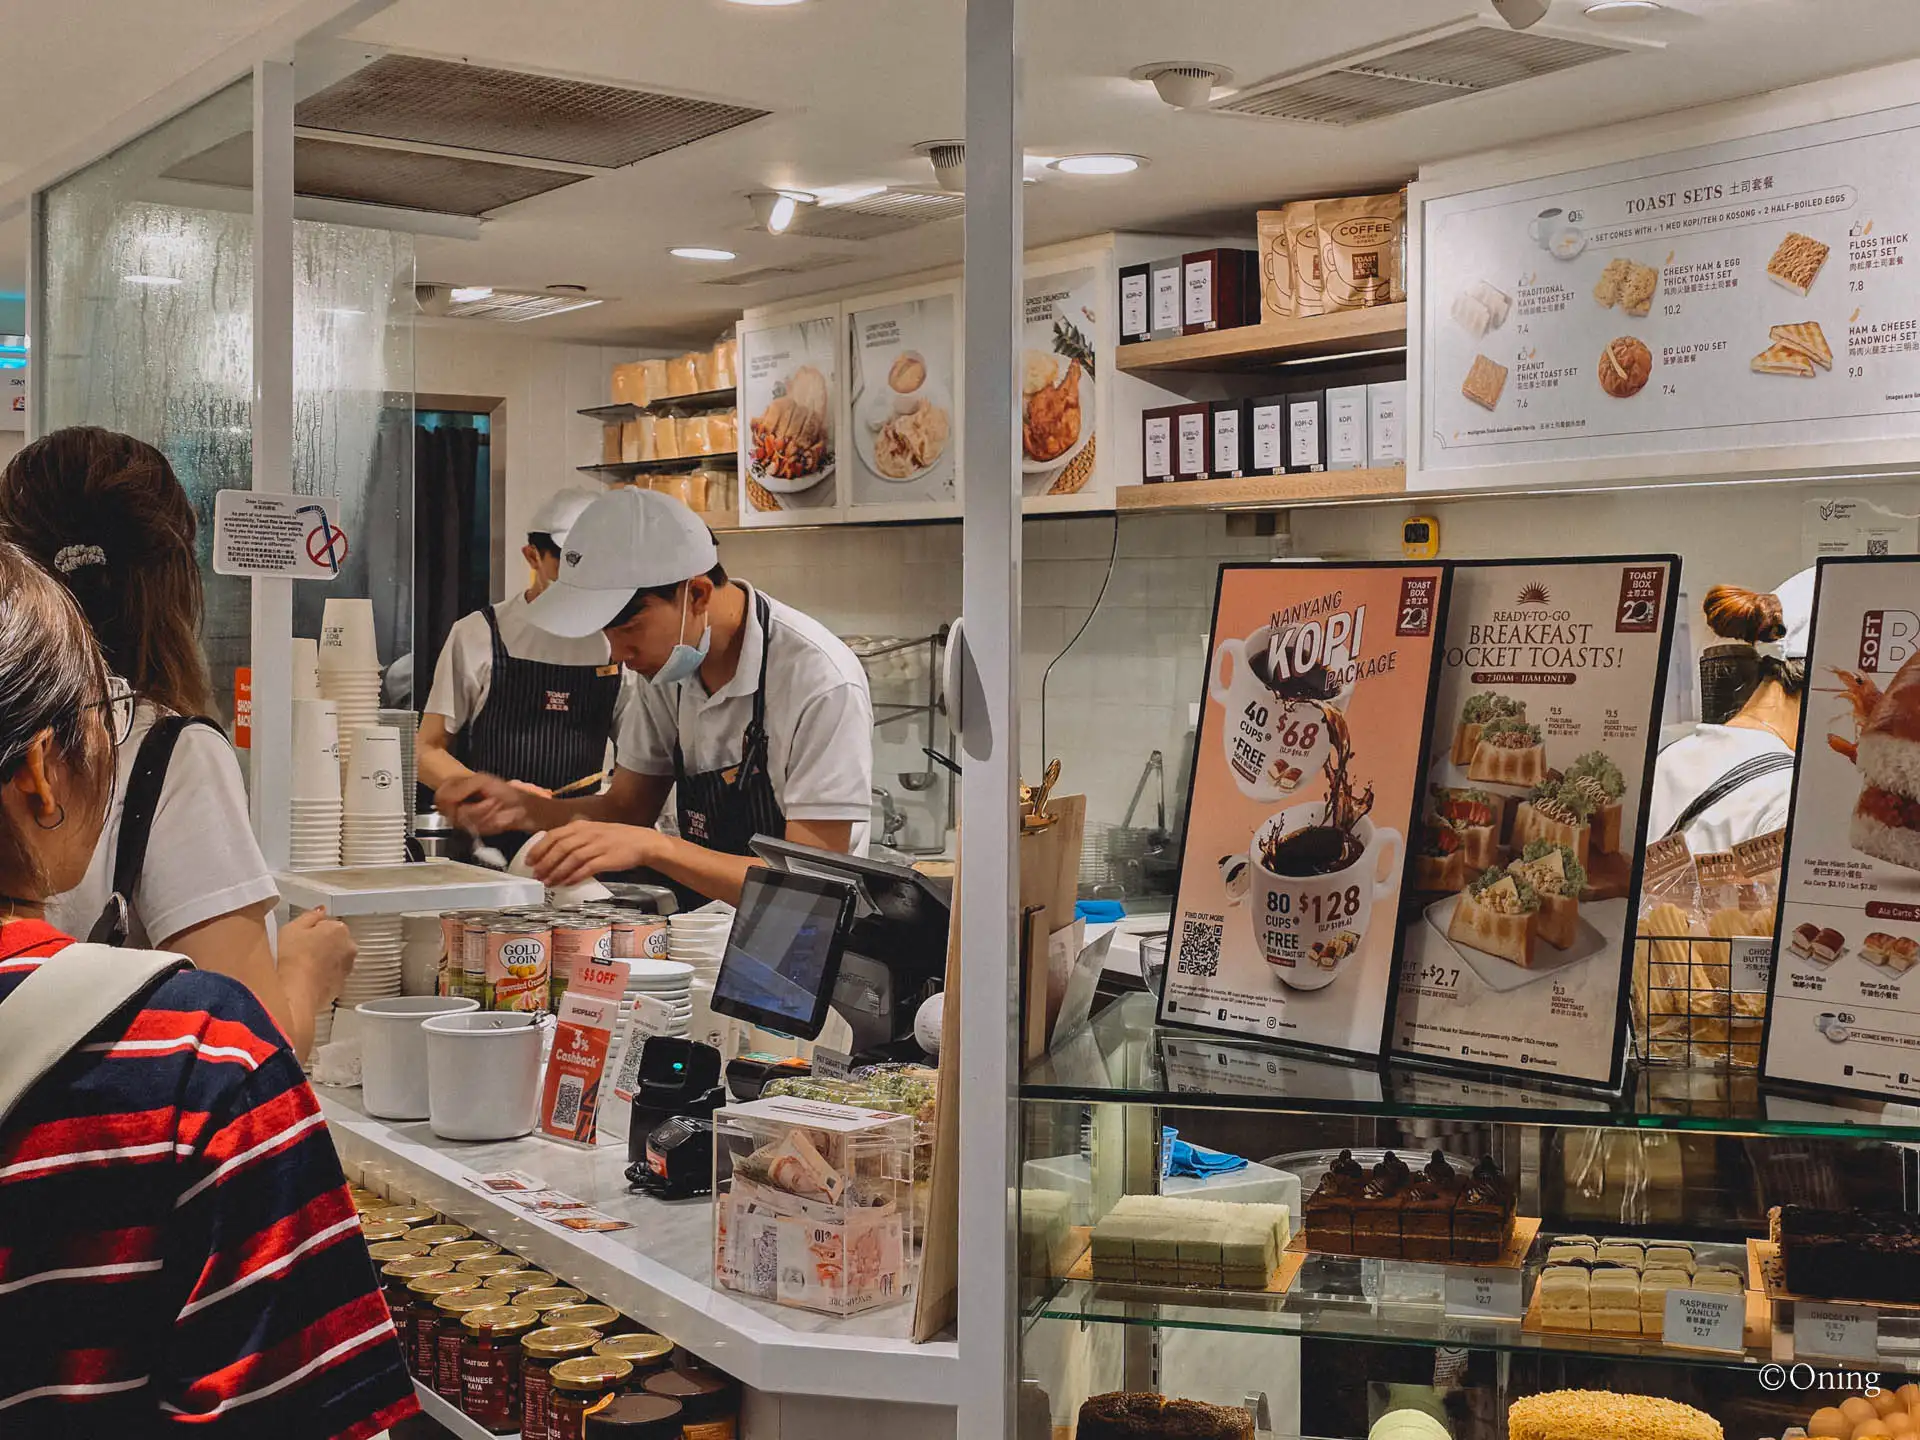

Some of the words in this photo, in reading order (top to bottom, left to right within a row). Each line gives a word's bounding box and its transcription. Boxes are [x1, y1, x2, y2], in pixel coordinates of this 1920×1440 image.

[1626, 191, 1676, 214] TOAST
[1683, 184, 1723, 205] SETS
[1729, 176, 1774, 196] 土司套餐
[1596, 232, 1608, 242] SET
[1610, 229, 1632, 240] COMES
[1634, 226, 1652, 236] WITH
[1666, 220, 1680, 231] MED
[1683, 215, 1717, 228] KOPI/TEH
[1726, 208, 1756, 220] KOSONG
[1770, 197, 1823, 213] HALF-BOILED
[1825, 193, 1846, 204] EGGS
[1340, 223, 1391, 236] COFFEE
[1850, 238, 1878, 250] FLOSS
[1880, 233, 1909, 246] THICK
[1850, 249, 1877, 260] TOAST
[1880, 246, 1898, 256] SET
[1664, 264, 1694, 276] CHEESY
[1696, 262, 1714, 272] HAM
[1716, 260, 1722, 268] &
[1724, 258, 1740, 268] EGG
[1664, 276, 1688, 286] THICK
[1690, 272, 1714, 282] TOAST
[1717, 270, 1732, 279] SET
[1518, 284, 1564, 298] TRADITIONAL
[1850, 280, 1864, 292] 7.8
[1518, 298, 1536, 307] KAYA
[1538, 294, 1560, 304] TOAST
[1561, 292, 1574, 301] SET
[1664, 304, 1681, 316] 10.2
[1517, 324, 1529, 334] 7.4
[1849, 325, 1868, 336] HAM
[1872, 324, 1878, 332] &
[1881, 320, 1917, 332] CHEESE
[1848, 334, 1897, 346] SANDWICH
[1900, 332, 1917, 340] SET
[1664, 347, 1674, 356] BO
[1676, 346, 1692, 354] LUO
[1694, 344, 1710, 352] YOU
[1712, 341, 1727, 350] SET
[1518, 362, 1544, 372] PEANUT
[1848, 366, 1863, 378] 9.0
[1518, 372, 1538, 382] THICK
[1540, 370, 1562, 379] TOAST
[1564, 368, 1578, 376] SET
[1663, 384, 1676, 394] 7.4
[1517, 400, 1528, 408] 7.6
[1630, 572, 1658, 580] TOAST
[1632, 580, 1652, 588] BOX
[1270, 590, 1342, 630] NANYANG
[1492, 610, 1571, 623] READY-TO-GO
[1468, 624, 1593, 645] BREAKFAST
[1266, 604, 1366, 683] KOPI
[1862, 615, 1881, 668] SOFT
[1446, 646, 1522, 668] OCKET
[1529, 646, 1624, 668] TOASTS!
[1324, 650, 1398, 692] PACKAGE
[1544, 674, 1568, 684] ONLY
[546, 690, 570, 698] TOAST
[1244, 700, 1268, 728] 40
[1240, 720, 1264, 743] CUPS
[1276, 712, 1320, 750] $68
[1702, 864, 1737, 874] BUTT
[1267, 891, 1290, 914] 80
[1298, 885, 1360, 924] $128
[1198, 912, 1208, 920] OUT
[1210, 914, 1224, 922] MORE
[1878, 907, 1890, 915] Ala
[1892, 908, 1912, 918] Carte
[1266, 914, 1291, 929] CUPS
[1262, 930, 1299, 950] +FREE
[504, 944, 540, 956] GOLD
[1281, 950, 1296, 958] TOAST
[1749, 948, 1770, 956] CHOC
[508, 956, 537, 964] COIN
[1744, 956, 1770, 964] BUTTE
[584, 968, 595, 982] $5
[596, 970, 617, 985] OFF
[1420, 964, 1460, 988] +$2.7
[1791, 973, 1804, 981] Kaya
[1890, 984, 1900, 992] Bun
[1476, 1295, 1492, 1304] $2.7
[1680, 1298, 1728, 1312] RASPBERRY
[1686, 1307, 1720, 1318] VANILLA
[1810, 1311, 1860, 1323] CHOCOLATE
[1694, 1326, 1710, 1337] $2.7
[1826, 1332, 1844, 1342] $2.7
[478, 1360, 490, 1368] BOX
[468, 1382, 482, 1391] KAYA
